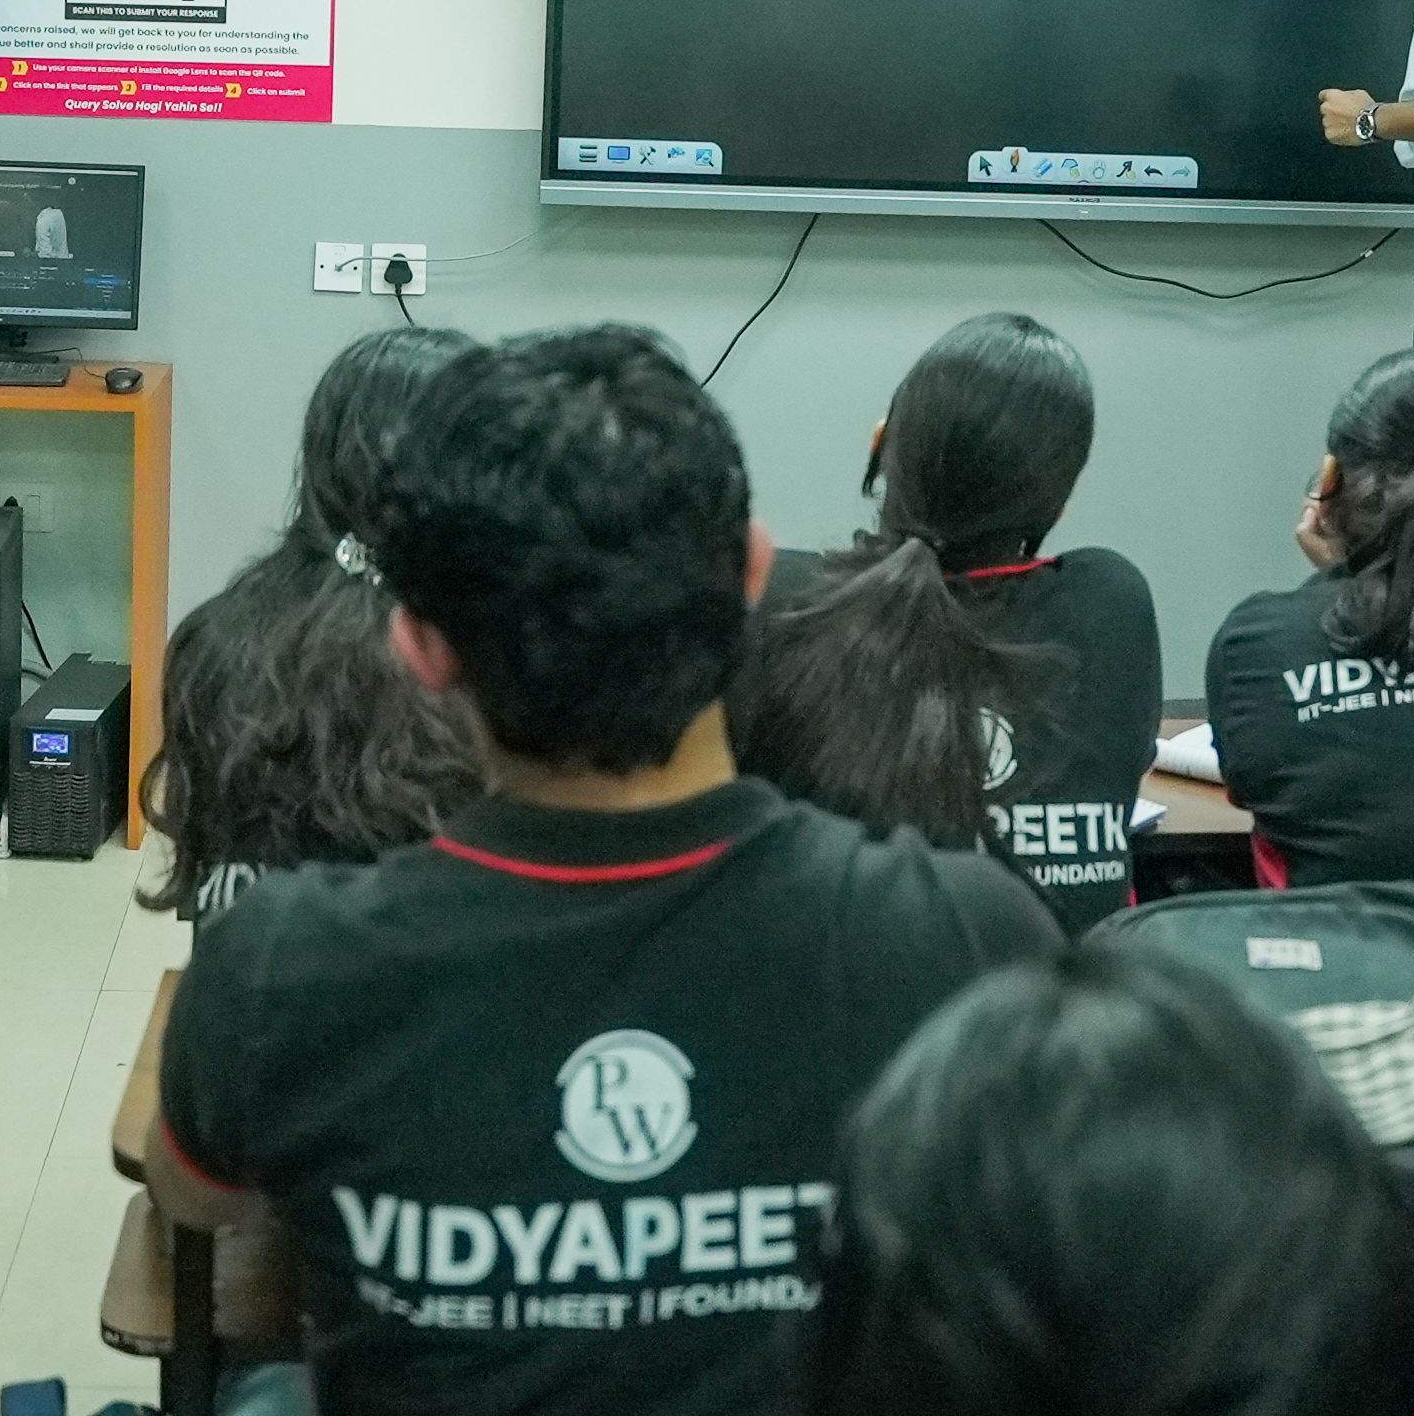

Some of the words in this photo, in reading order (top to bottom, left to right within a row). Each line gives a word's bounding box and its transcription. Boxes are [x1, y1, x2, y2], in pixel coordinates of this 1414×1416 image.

[72, 6, 95, 15] SCAN
[95, 6, 113, 15] THIS
[114, 7, 126, 16] TO
[126, 7, 156, 16] SUBMIT
[156, 8, 178, 17] YOUR
[179, 9, 219, 18] RESPONSE
[80, 27, 95, 35] we
[99, 26, 116, 35] will
[118, 27, 135, 38] get
[137, 27, 162, 36] back
[165, 28, 175, 37] to
[177, 29, 196, 39] you
[198, 29, 212, 38] for
[214, 30, 290, 42] understanding
[292, 31, 309, 40] the
[65, 98, 101, 113] Query
[101, 99, 134, 111] Solve
[135, 100, 163, 114] Hogi
[164, 101, 198, 113] Yahin
[523, 1291, 634, 1332] NEET
